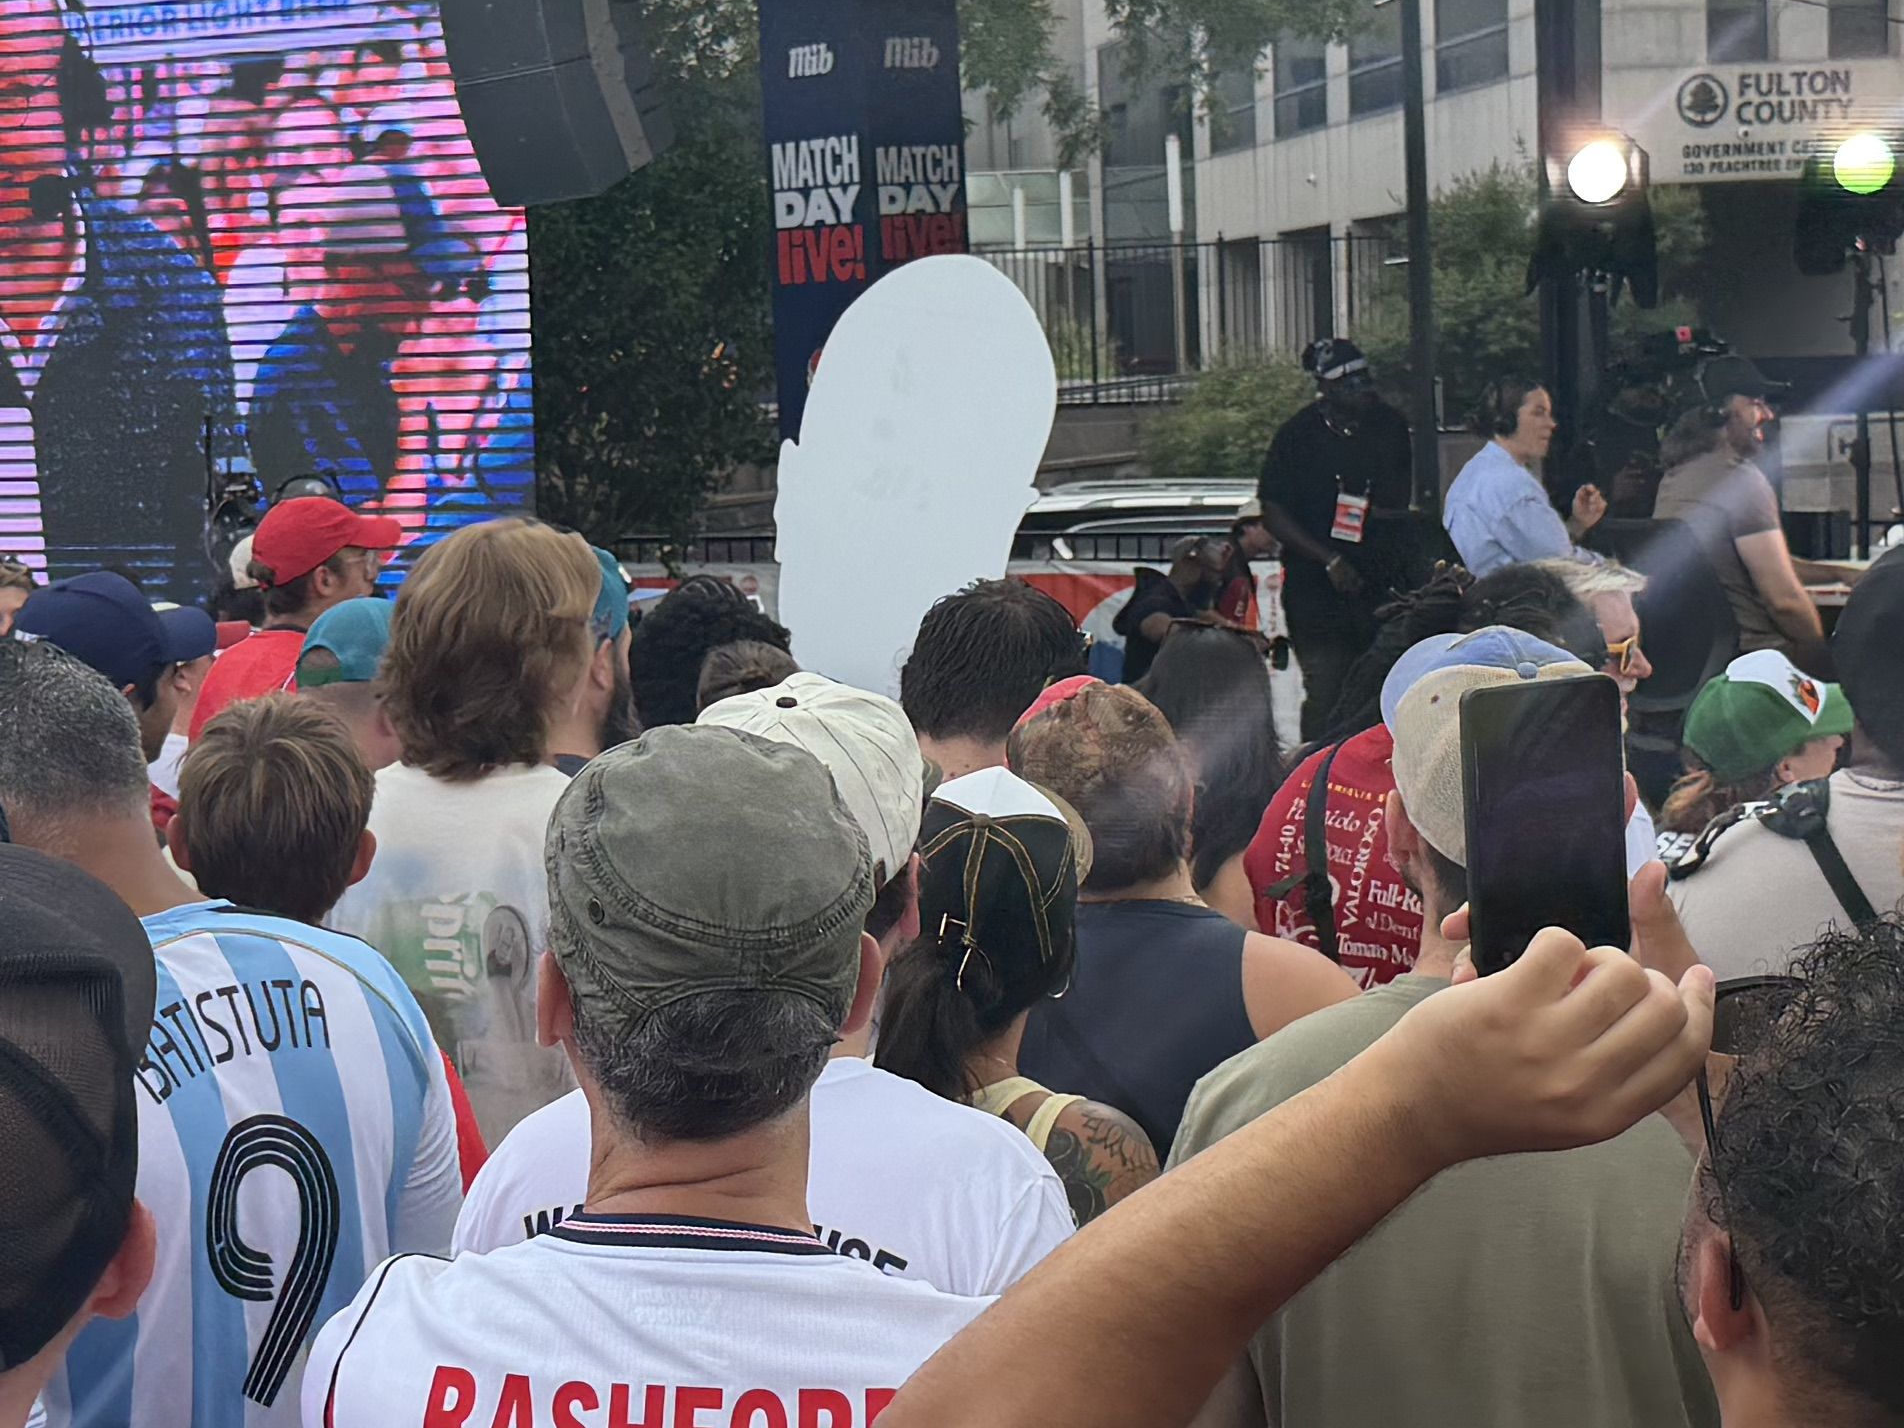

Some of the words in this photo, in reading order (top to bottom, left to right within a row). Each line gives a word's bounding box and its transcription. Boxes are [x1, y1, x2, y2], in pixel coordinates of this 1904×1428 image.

[1738, 70, 1851, 98] FULTON
[1735, 98, 1853, 125] COUNTY
[771, 134, 861, 190] MATCH
[875, 145, 960, 185] MATCH
[1682, 140, 1785, 159] GOVERNMENT
[774, 184, 861, 229] DAY
[877, 183, 959, 215] DAY
[777, 224, 866, 285] live!
[880, 213, 967, 260] live!
[1342, 807, 1383, 927] VALOROSO
[1380, 913, 1421, 940] Dent
[206, 1113, 340, 1408] 9
